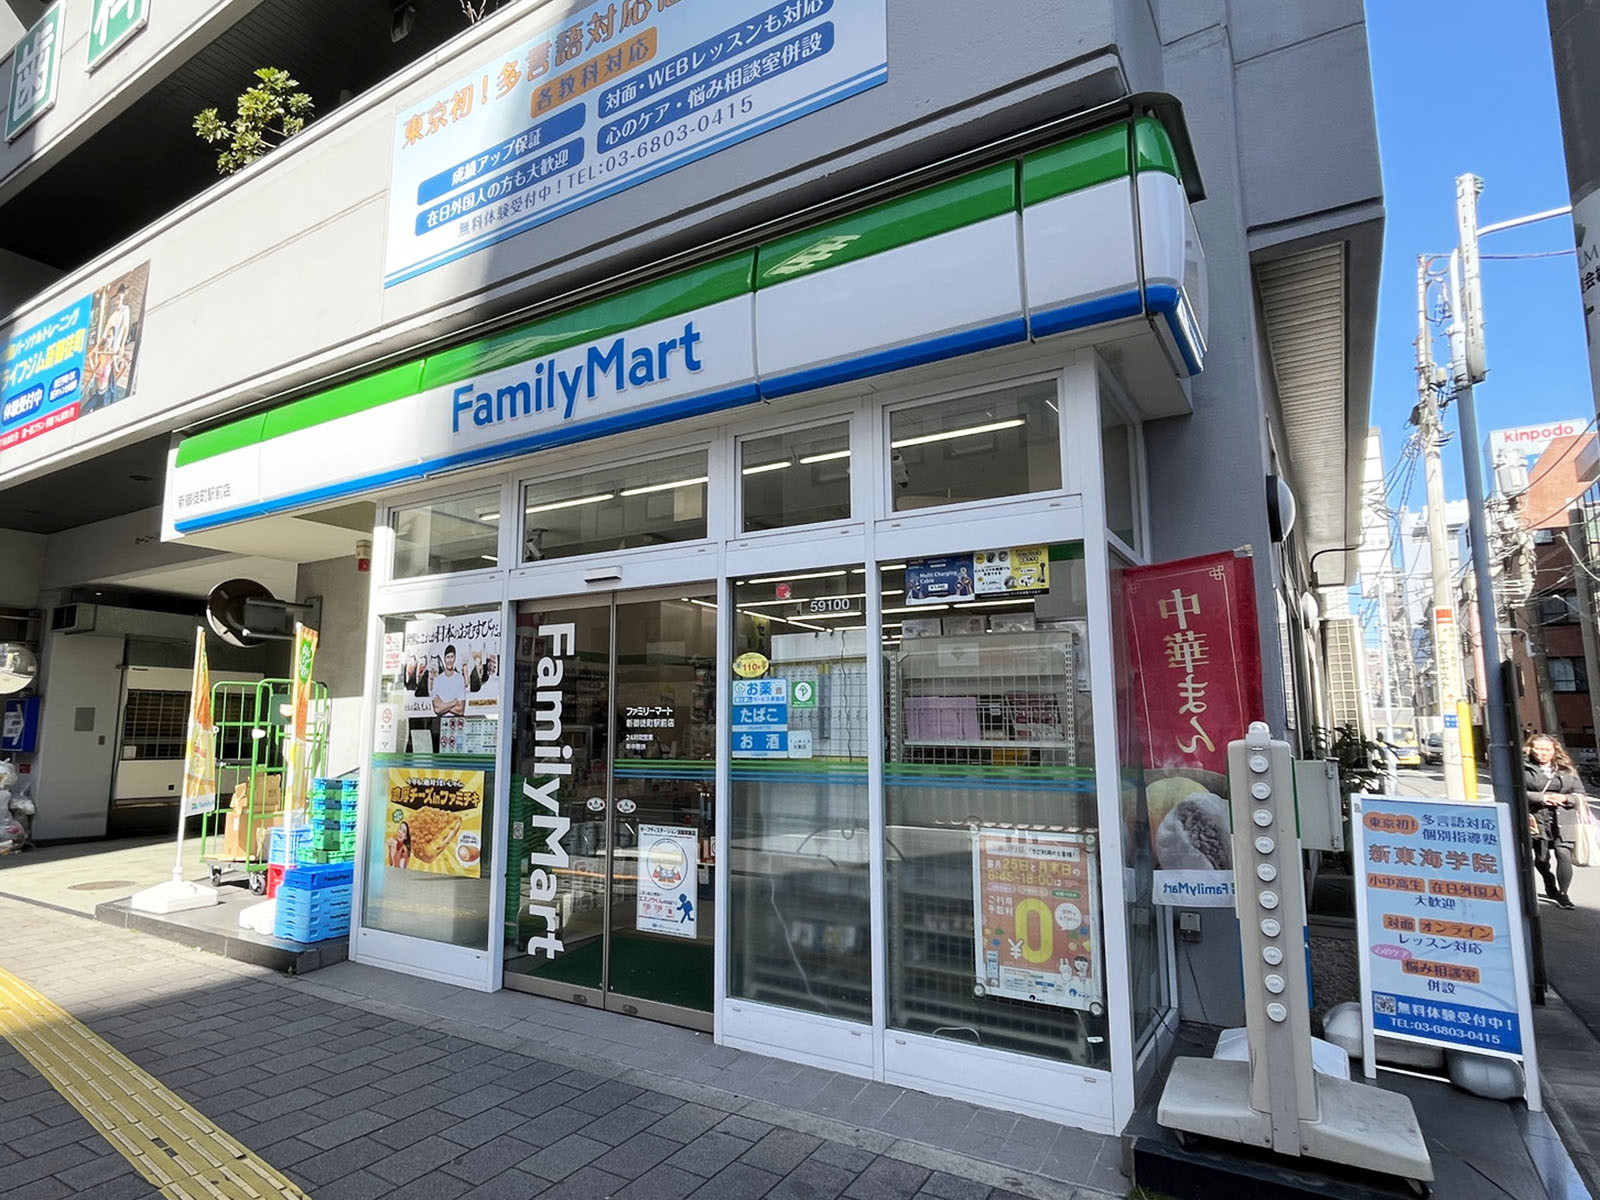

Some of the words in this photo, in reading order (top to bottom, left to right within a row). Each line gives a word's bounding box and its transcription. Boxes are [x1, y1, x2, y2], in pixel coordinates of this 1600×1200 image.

[402, 0, 682, 149] 東京初！多言語対応
[537, 38, 650, 111] 各教科対応
[604, 32, 822, 145] 心のケア・悩み相談室併設
[451, 127, 542, 186] 成績アップ保証
[426, 149, 569, 229] 在日外国人の方も大歓迎
[452, 320, 702, 433] FamilyMart
[1504, 423, 1575, 443] kinpodo
[810, 598, 850, 612] 59100
[746, 681, 772, 696] お薬
[626, 706, 674, 716] ファミリーマート
[740, 707, 779, 722] たばこ
[523, 622, 576, 960] FamilyMart
[1422, 814, 1496, 831] 多言語対応
[1422, 828, 1498, 846] 個別指導塾
[1368, 843, 1499, 875] 新東海学院
[1369, 875, 1423, 892] 小中高生
[1432, 882, 1503, 900] 在日外国人
[1415, 895, 1456, 910] 大歓迎
[1386, 916, 1414, 931] 対面
[1421, 921, 1492, 940] オンライン
[1398, 933, 1483, 956] レッスン対応
[1405, 961, 1477, 980] 悩み相談室
[1427, 980, 1457, 995] 併設
[1390, 1017, 1501, 1045] TEL:03-6803-0415
